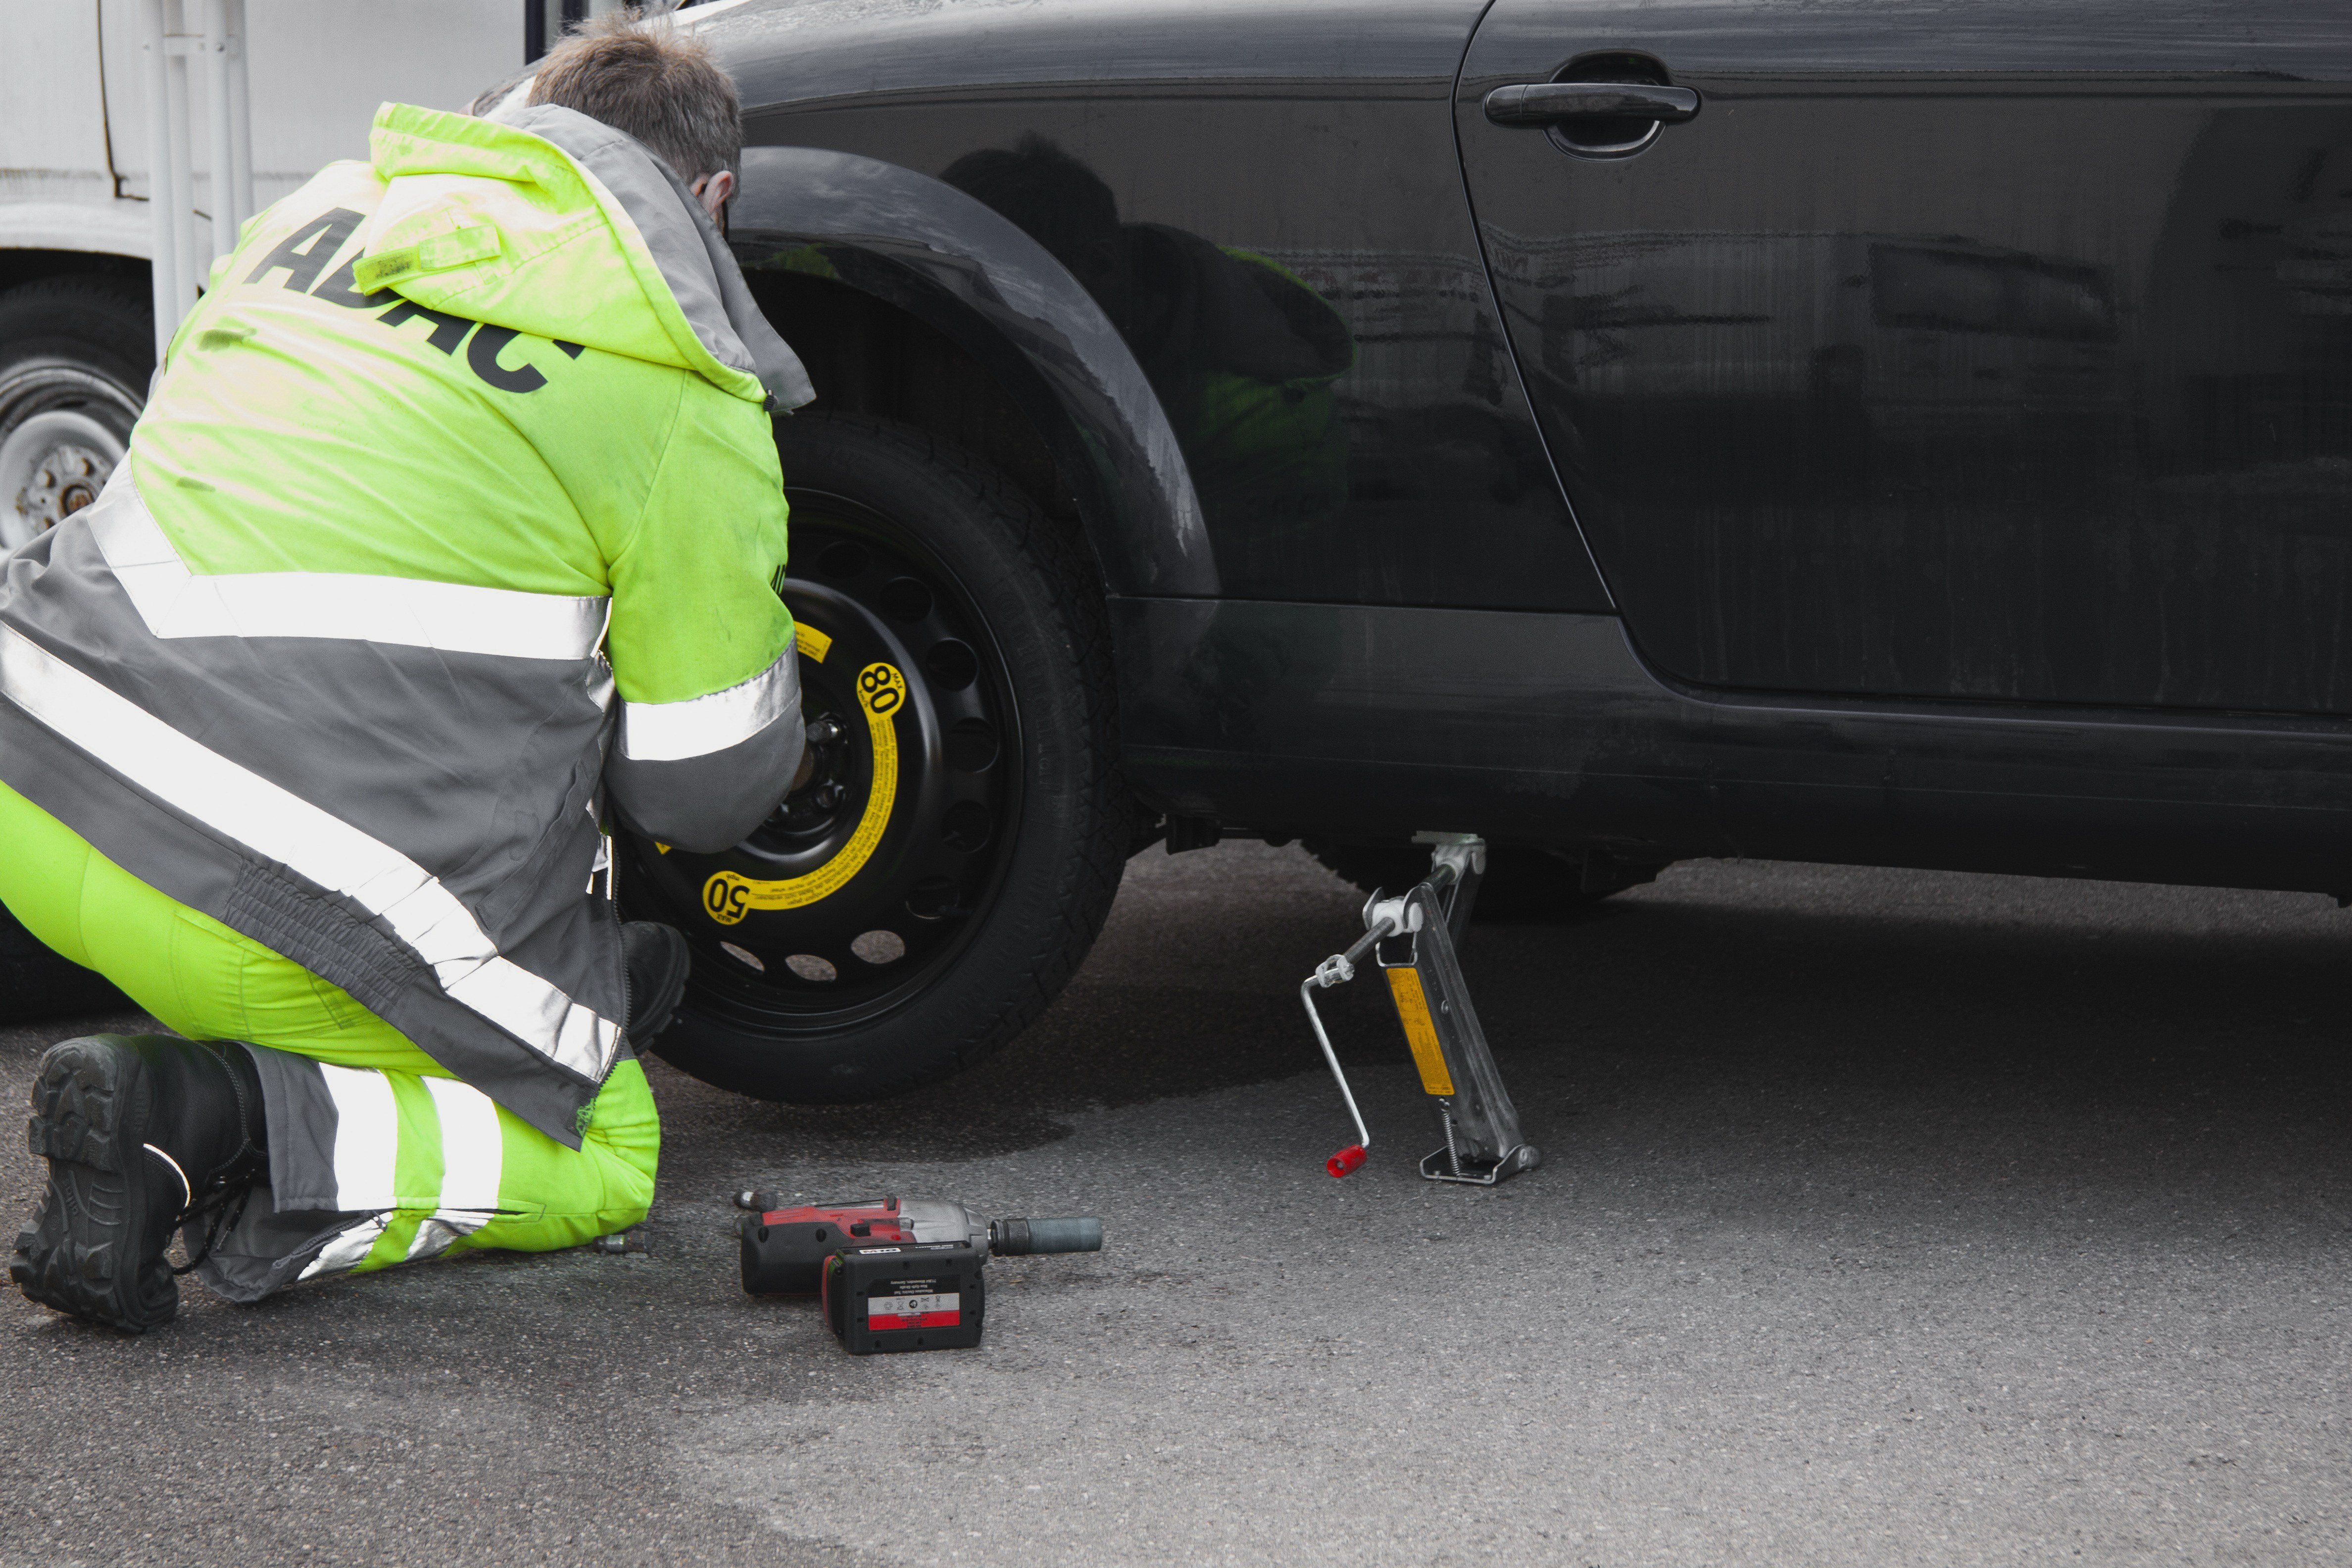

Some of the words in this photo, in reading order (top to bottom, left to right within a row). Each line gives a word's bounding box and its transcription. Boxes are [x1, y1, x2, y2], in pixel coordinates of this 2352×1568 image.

[861, 666, 899, 713] 80
[891, 673, 902, 690] MAX
[708, 879, 750, 918] 50
[717, 913, 732, 923] MAX
